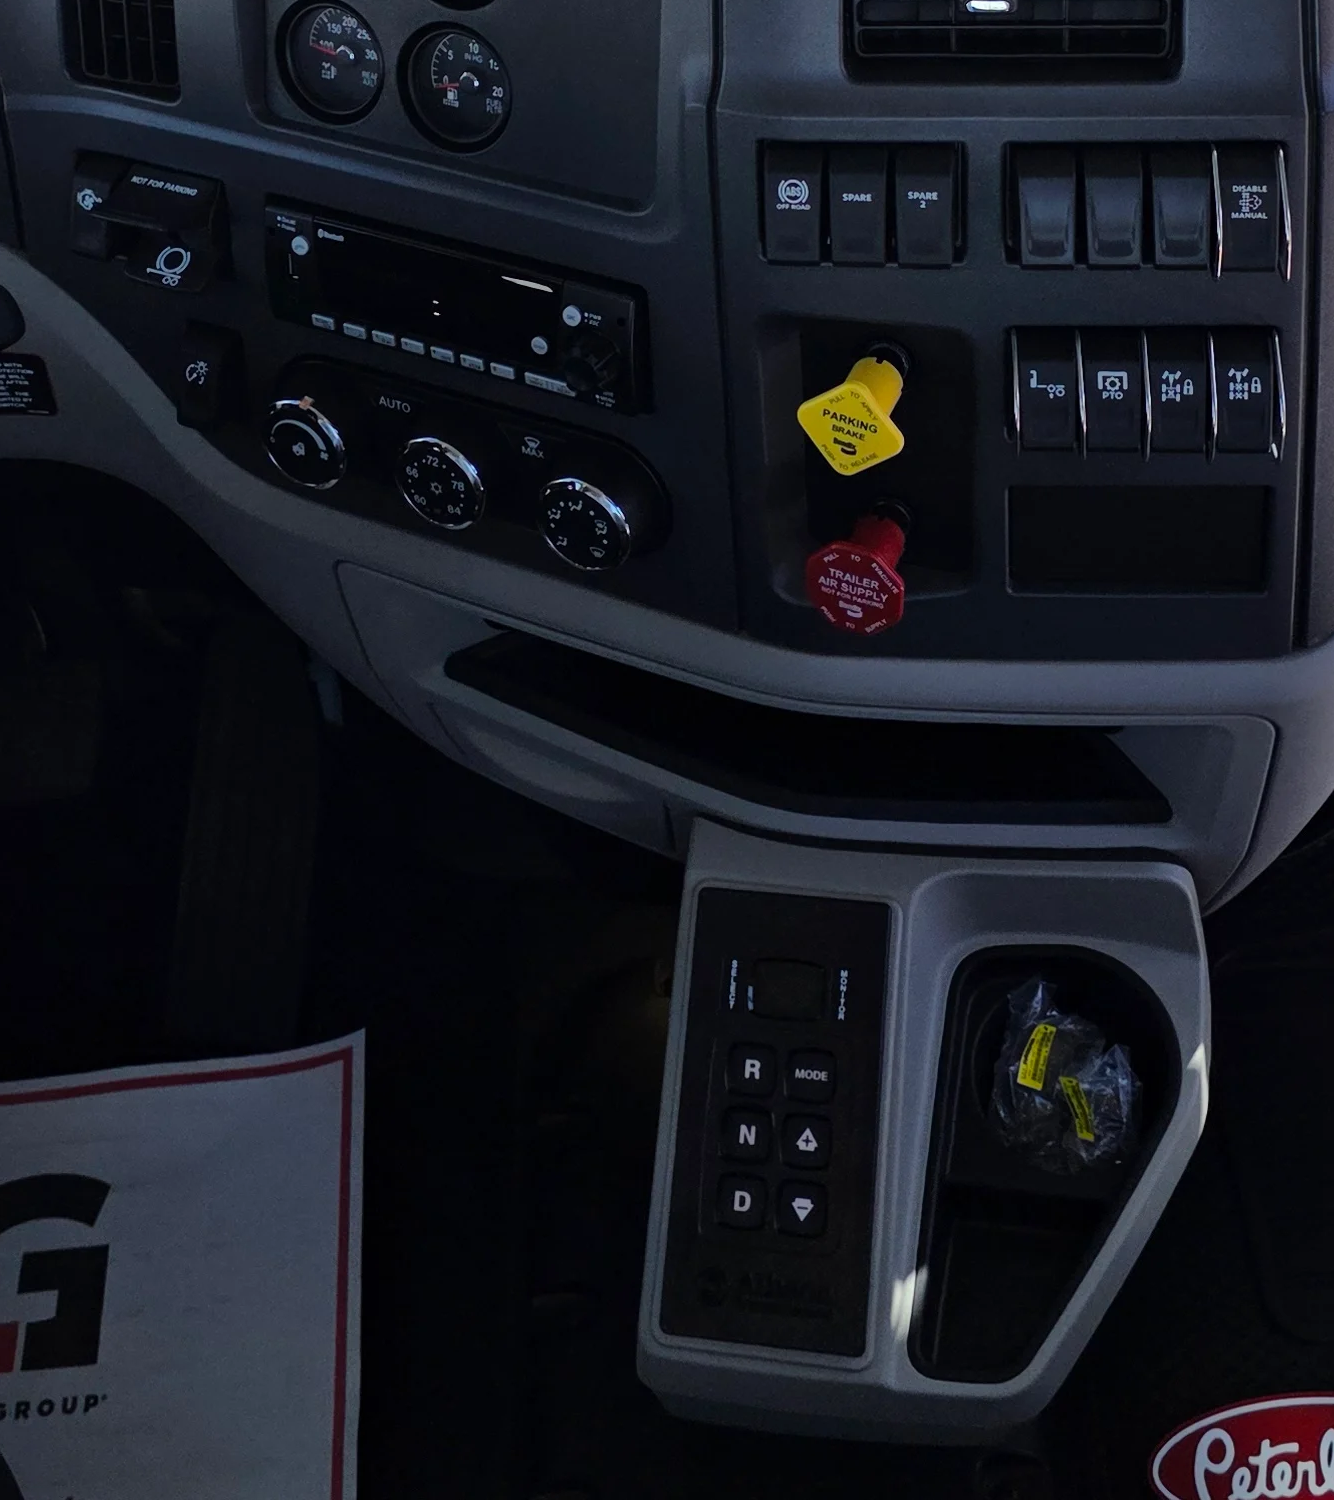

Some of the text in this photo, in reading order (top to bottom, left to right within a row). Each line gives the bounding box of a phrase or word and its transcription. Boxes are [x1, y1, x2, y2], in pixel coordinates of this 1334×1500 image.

[342, 15, 357, 28] 200
[327, 23, 342, 34] 150
[469, 42, 479, 54] 10
[447, 50, 454, 61] 5
[492, 86, 503, 98] 20
[131, 175, 198, 197] NOT FOR PARKING
[785, 186, 802, 197] ABS
[1232, 185, 1268, 193] DISABLE
[842, 193, 873, 202] SPARE
[907, 191, 938, 201] SPARE
[919, 200, 926, 209] 2
[1231, 211, 1268, 220] MANUAL
[828, 393, 846, 406] PULL
[849, 390, 861, 400] TO
[1102, 390, 1124, 400] PTO
[378, 395, 411, 414] AUTO
[822, 408, 878, 434] PARKING
[831, 423, 867, 442] BRAKE
[521, 445, 545, 459] MAX
[425, 455, 440, 468] 72
[838, 462, 850, 472] TO
[850, 452, 879, 469] RELEASE
[406, 466, 419, 479] 66
[451, 480, 465, 492] 78
[413, 494, 427, 506] 60
[447, 504, 462, 516] 84
[828, 567, 880, 591] TRAILER
[850, 554, 861, 563] TO
[871, 562, 900, 595] EVACUATE
[818, 575, 888, 603] AIR SUPPLY
[821, 585, 885, 610] NOT FOR PARKING
[845, 621, 856, 630] TO
[728, 959, 739, 1011] SELECT
[837, 969, 849, 1021] MONITOR
[744, 1058, 762, 1081] R
[794, 1067, 829, 1082] MODE
[738, 1123, 757, 1147] N
[733, 1190, 752, 1213] D
